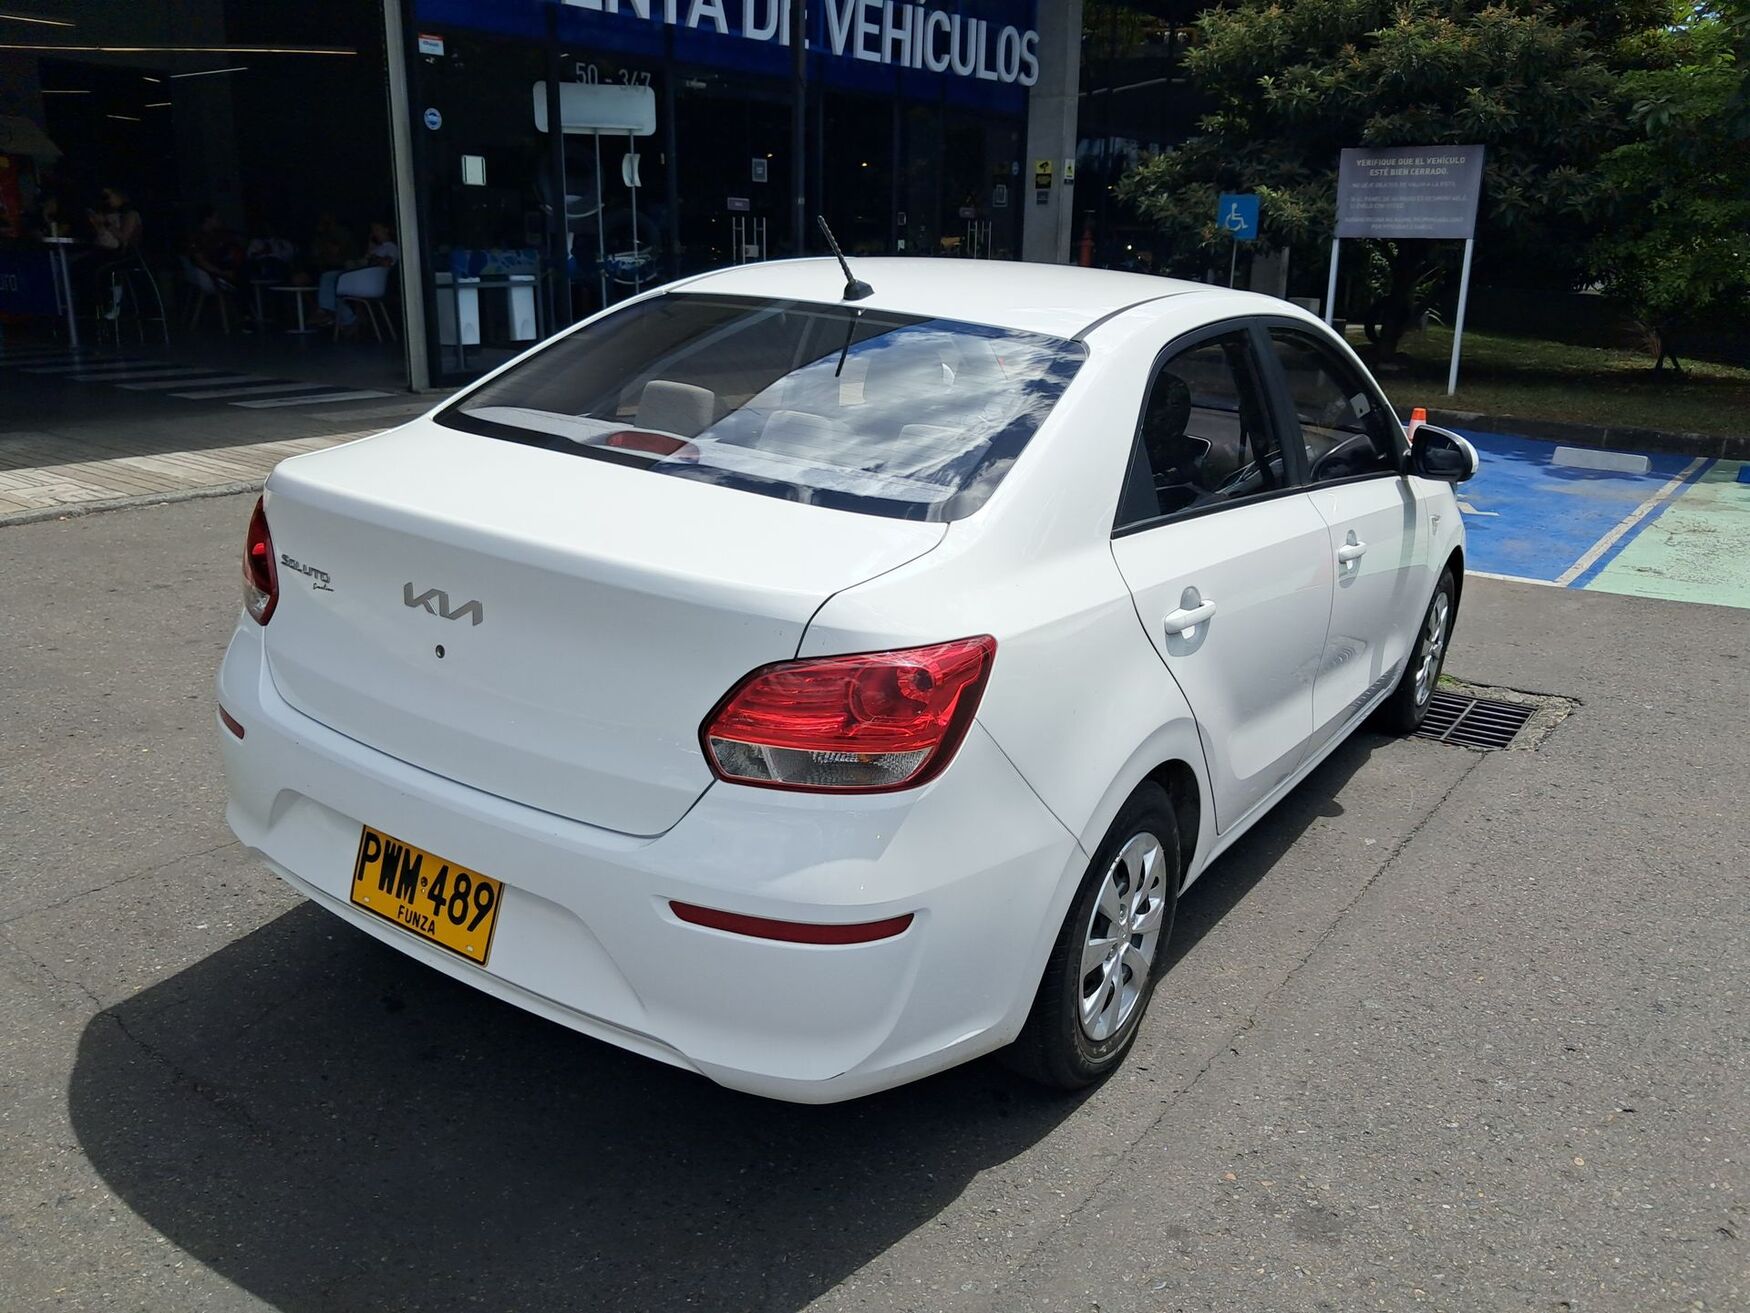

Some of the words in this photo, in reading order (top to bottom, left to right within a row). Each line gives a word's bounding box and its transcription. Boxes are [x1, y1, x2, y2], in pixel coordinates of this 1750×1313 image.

[825, 0, 1040, 87] VEHÍCULOS
[576, 62, 598, 86] 50
[281, 554, 331, 583] SOLUTO
[404, 581, 483, 626] KIA
[357, 831, 424, 905] PWM
[427, 864, 495, 932] 489
[397, 904, 436, 936] FUNZA
